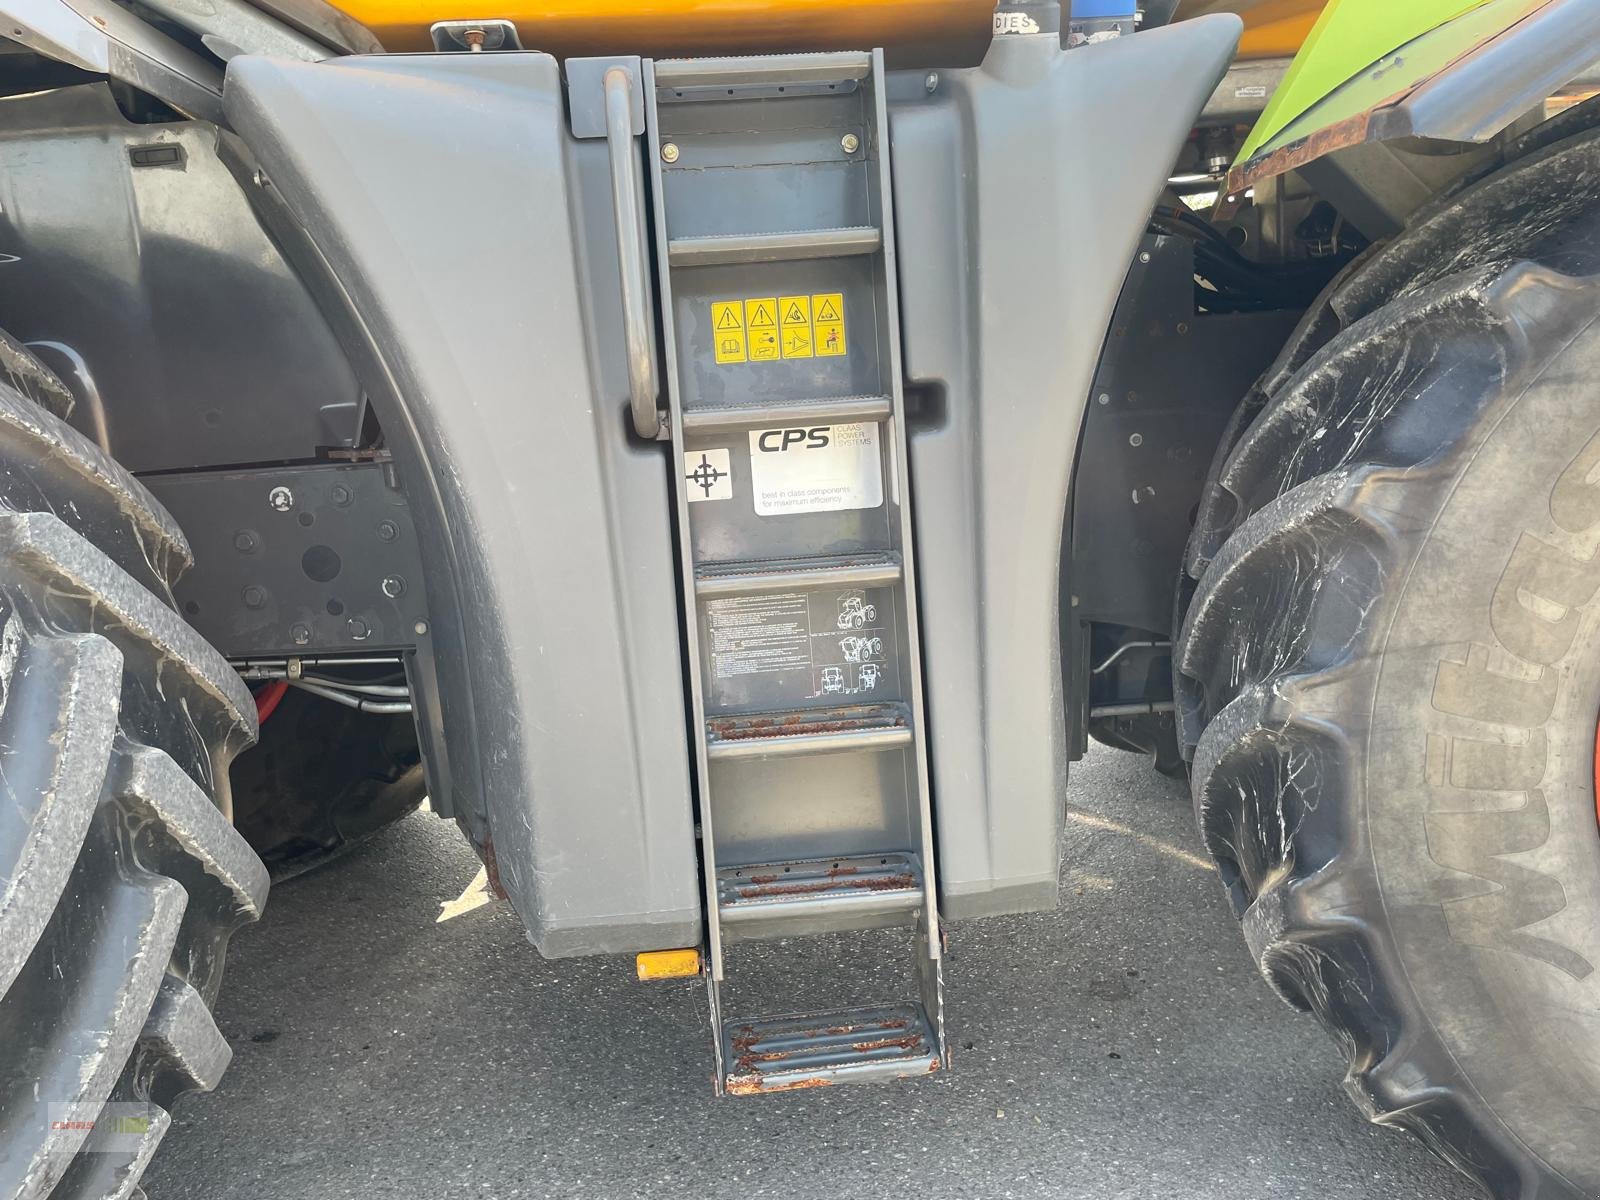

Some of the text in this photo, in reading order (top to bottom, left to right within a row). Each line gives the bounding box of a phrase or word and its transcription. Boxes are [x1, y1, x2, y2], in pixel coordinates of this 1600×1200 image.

[759, 426, 831, 453] CPS
[837, 432, 865, 440] POWER
[839, 438, 872, 447] SYSTEMS
[762, 490, 778, 499] best
[787, 489, 805, 498] class
[806, 486, 851, 497] components
[762, 495, 843, 507] for maximum efficiency
